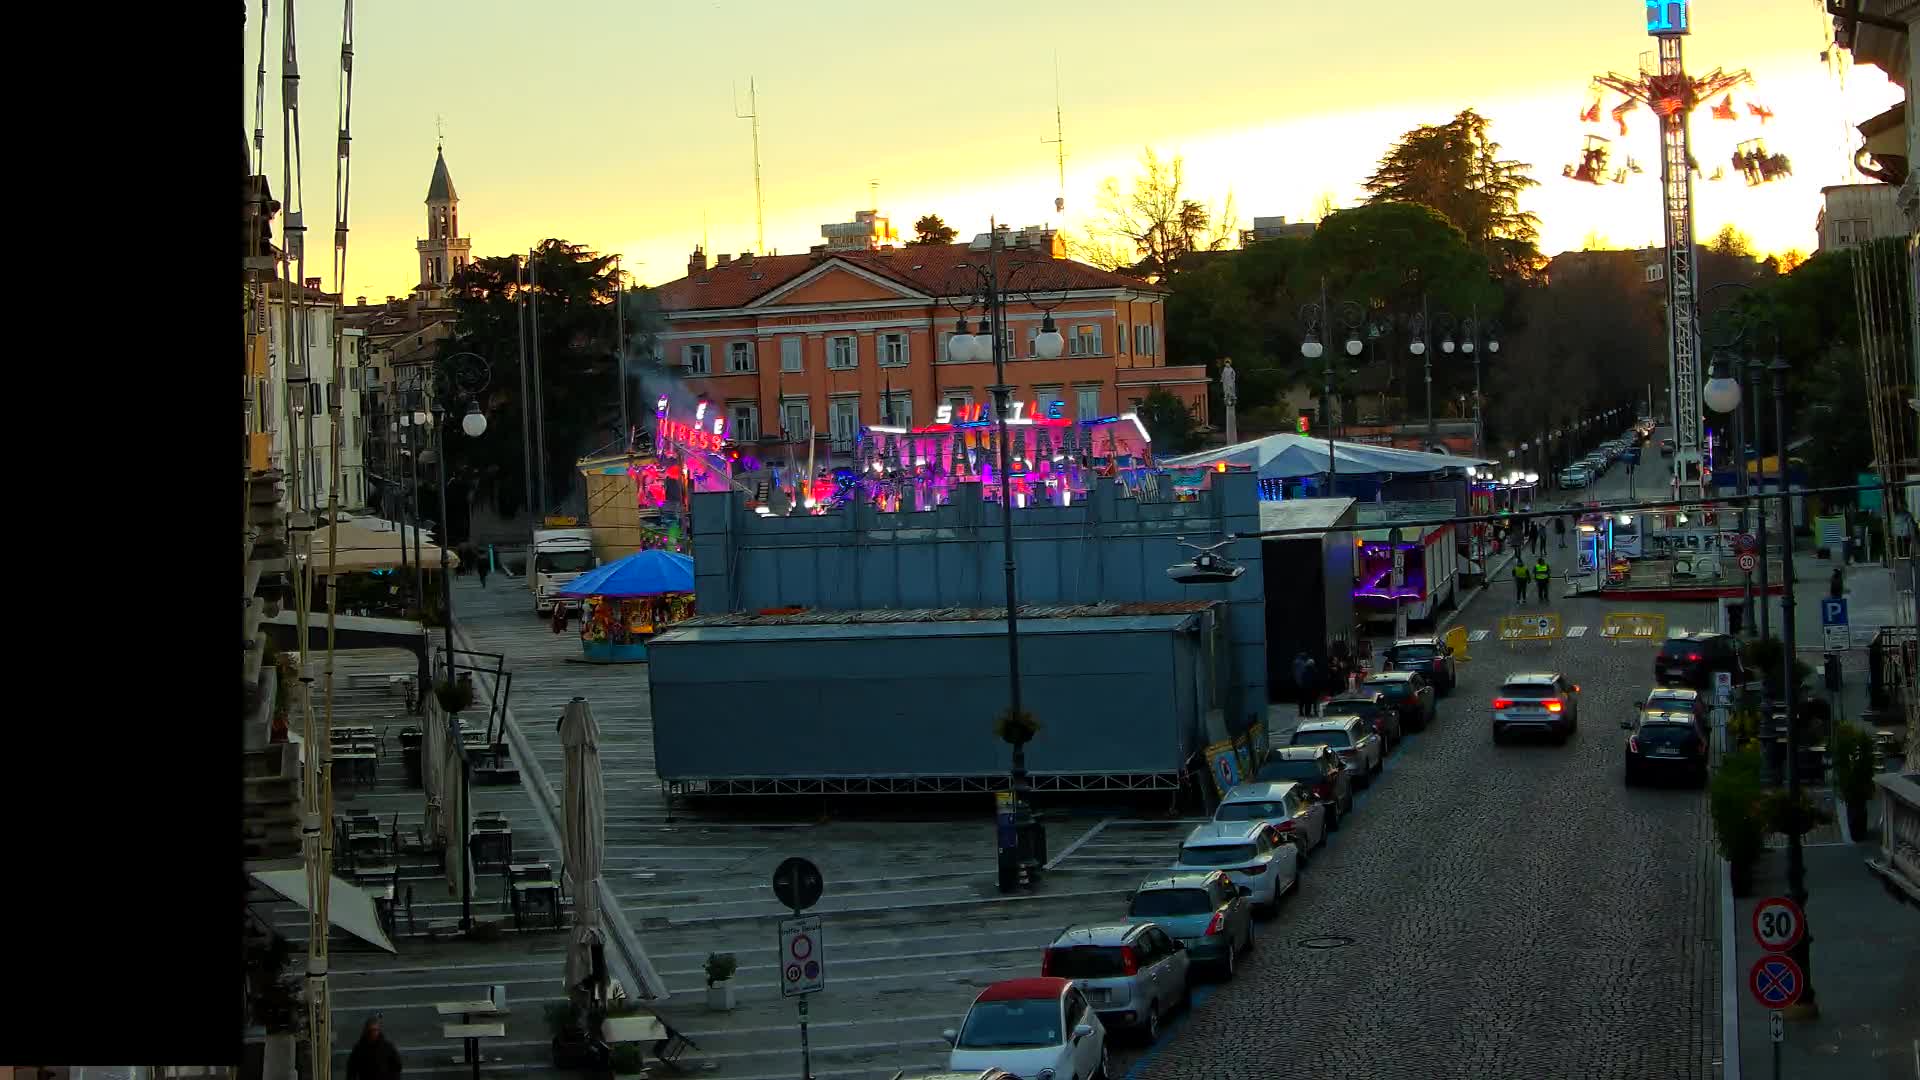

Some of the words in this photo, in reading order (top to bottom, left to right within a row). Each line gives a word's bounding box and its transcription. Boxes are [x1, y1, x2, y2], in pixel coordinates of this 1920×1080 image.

[1742, 558, 1753, 567] 20
[1826, 602, 1841, 622] P
[1762, 912, 1791, 938] 30
